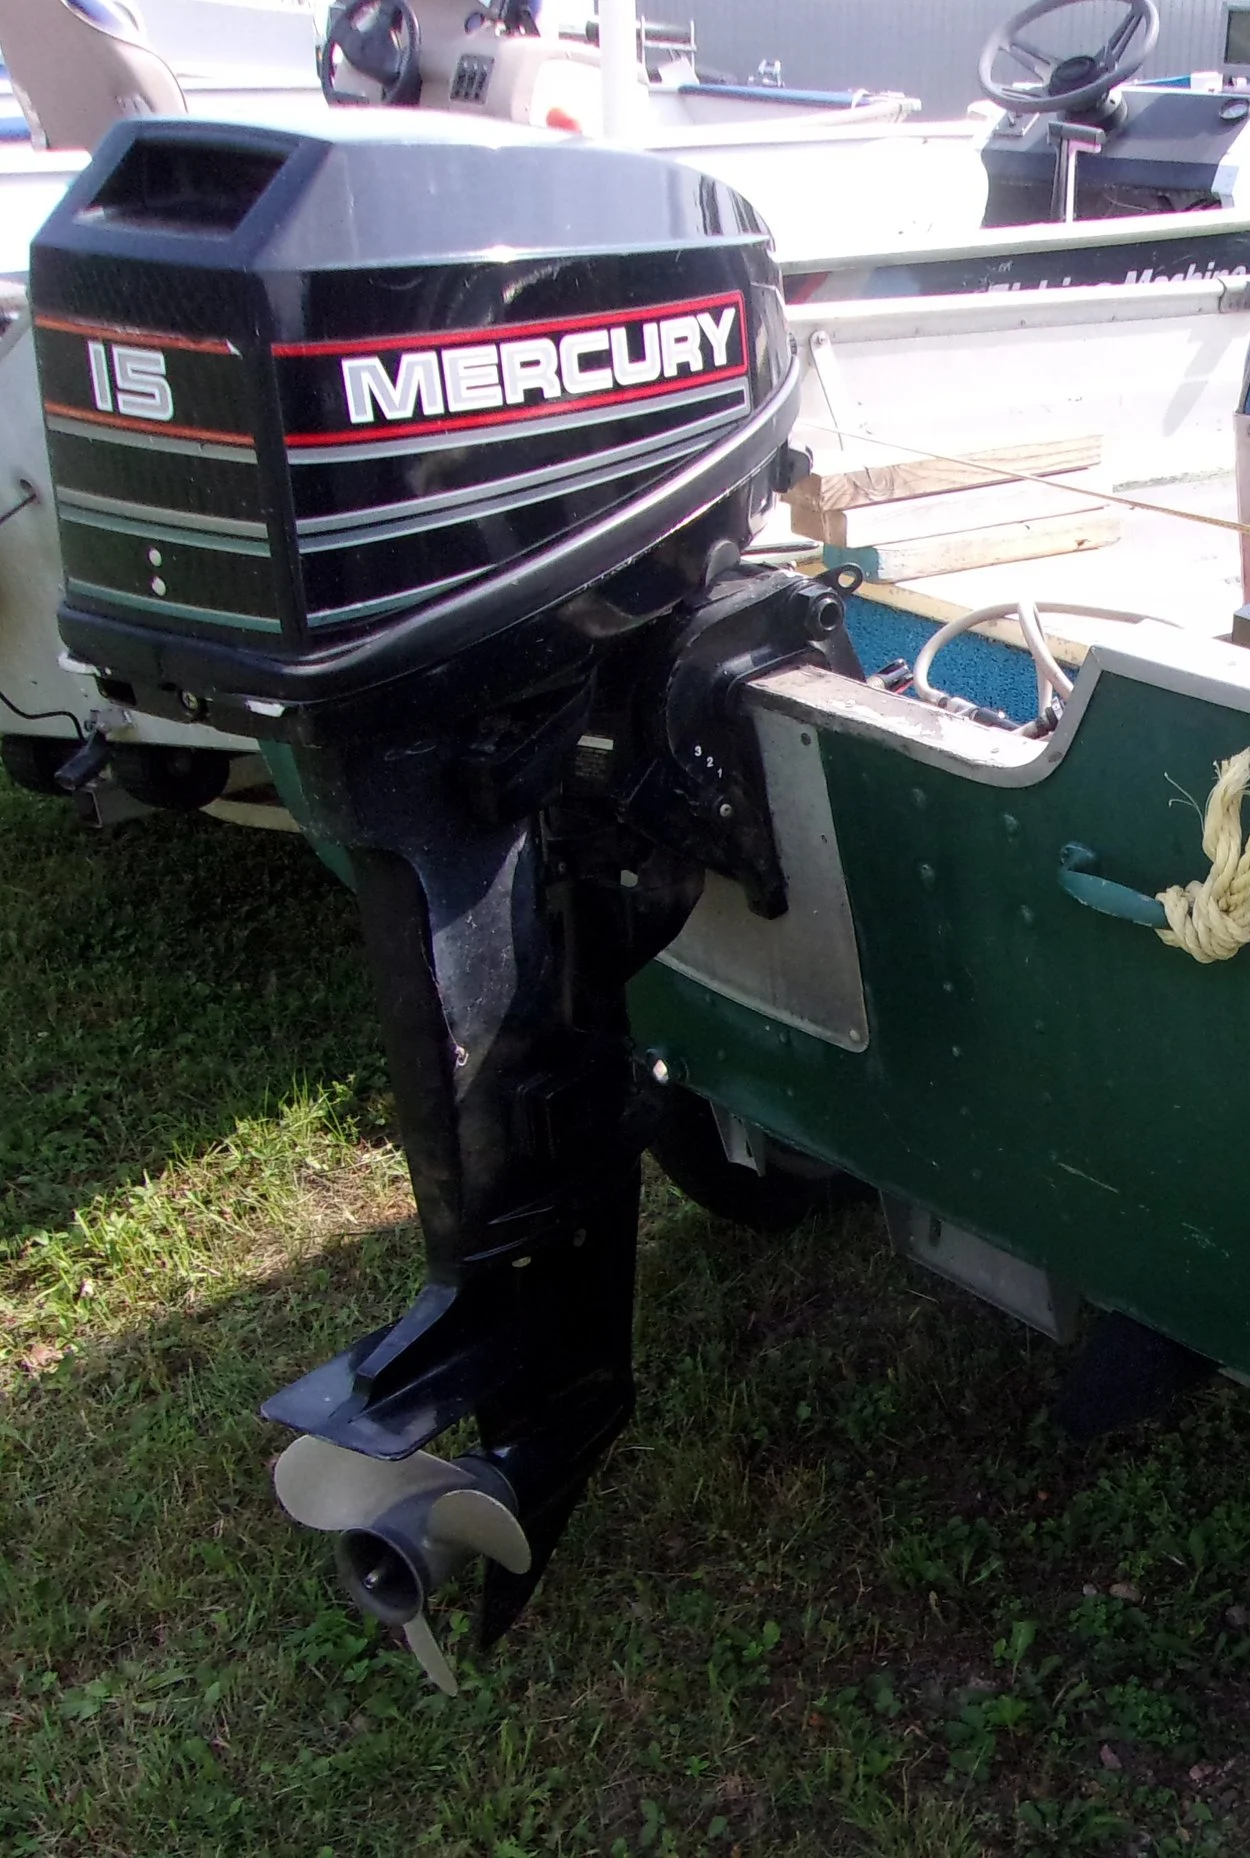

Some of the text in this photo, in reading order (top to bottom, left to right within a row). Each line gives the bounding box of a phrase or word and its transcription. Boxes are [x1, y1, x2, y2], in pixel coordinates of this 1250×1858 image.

[87, 340, 174, 421] 15
[341, 307, 736, 424] MERCURY
[694, 745, 723, 779] 3 2 1
